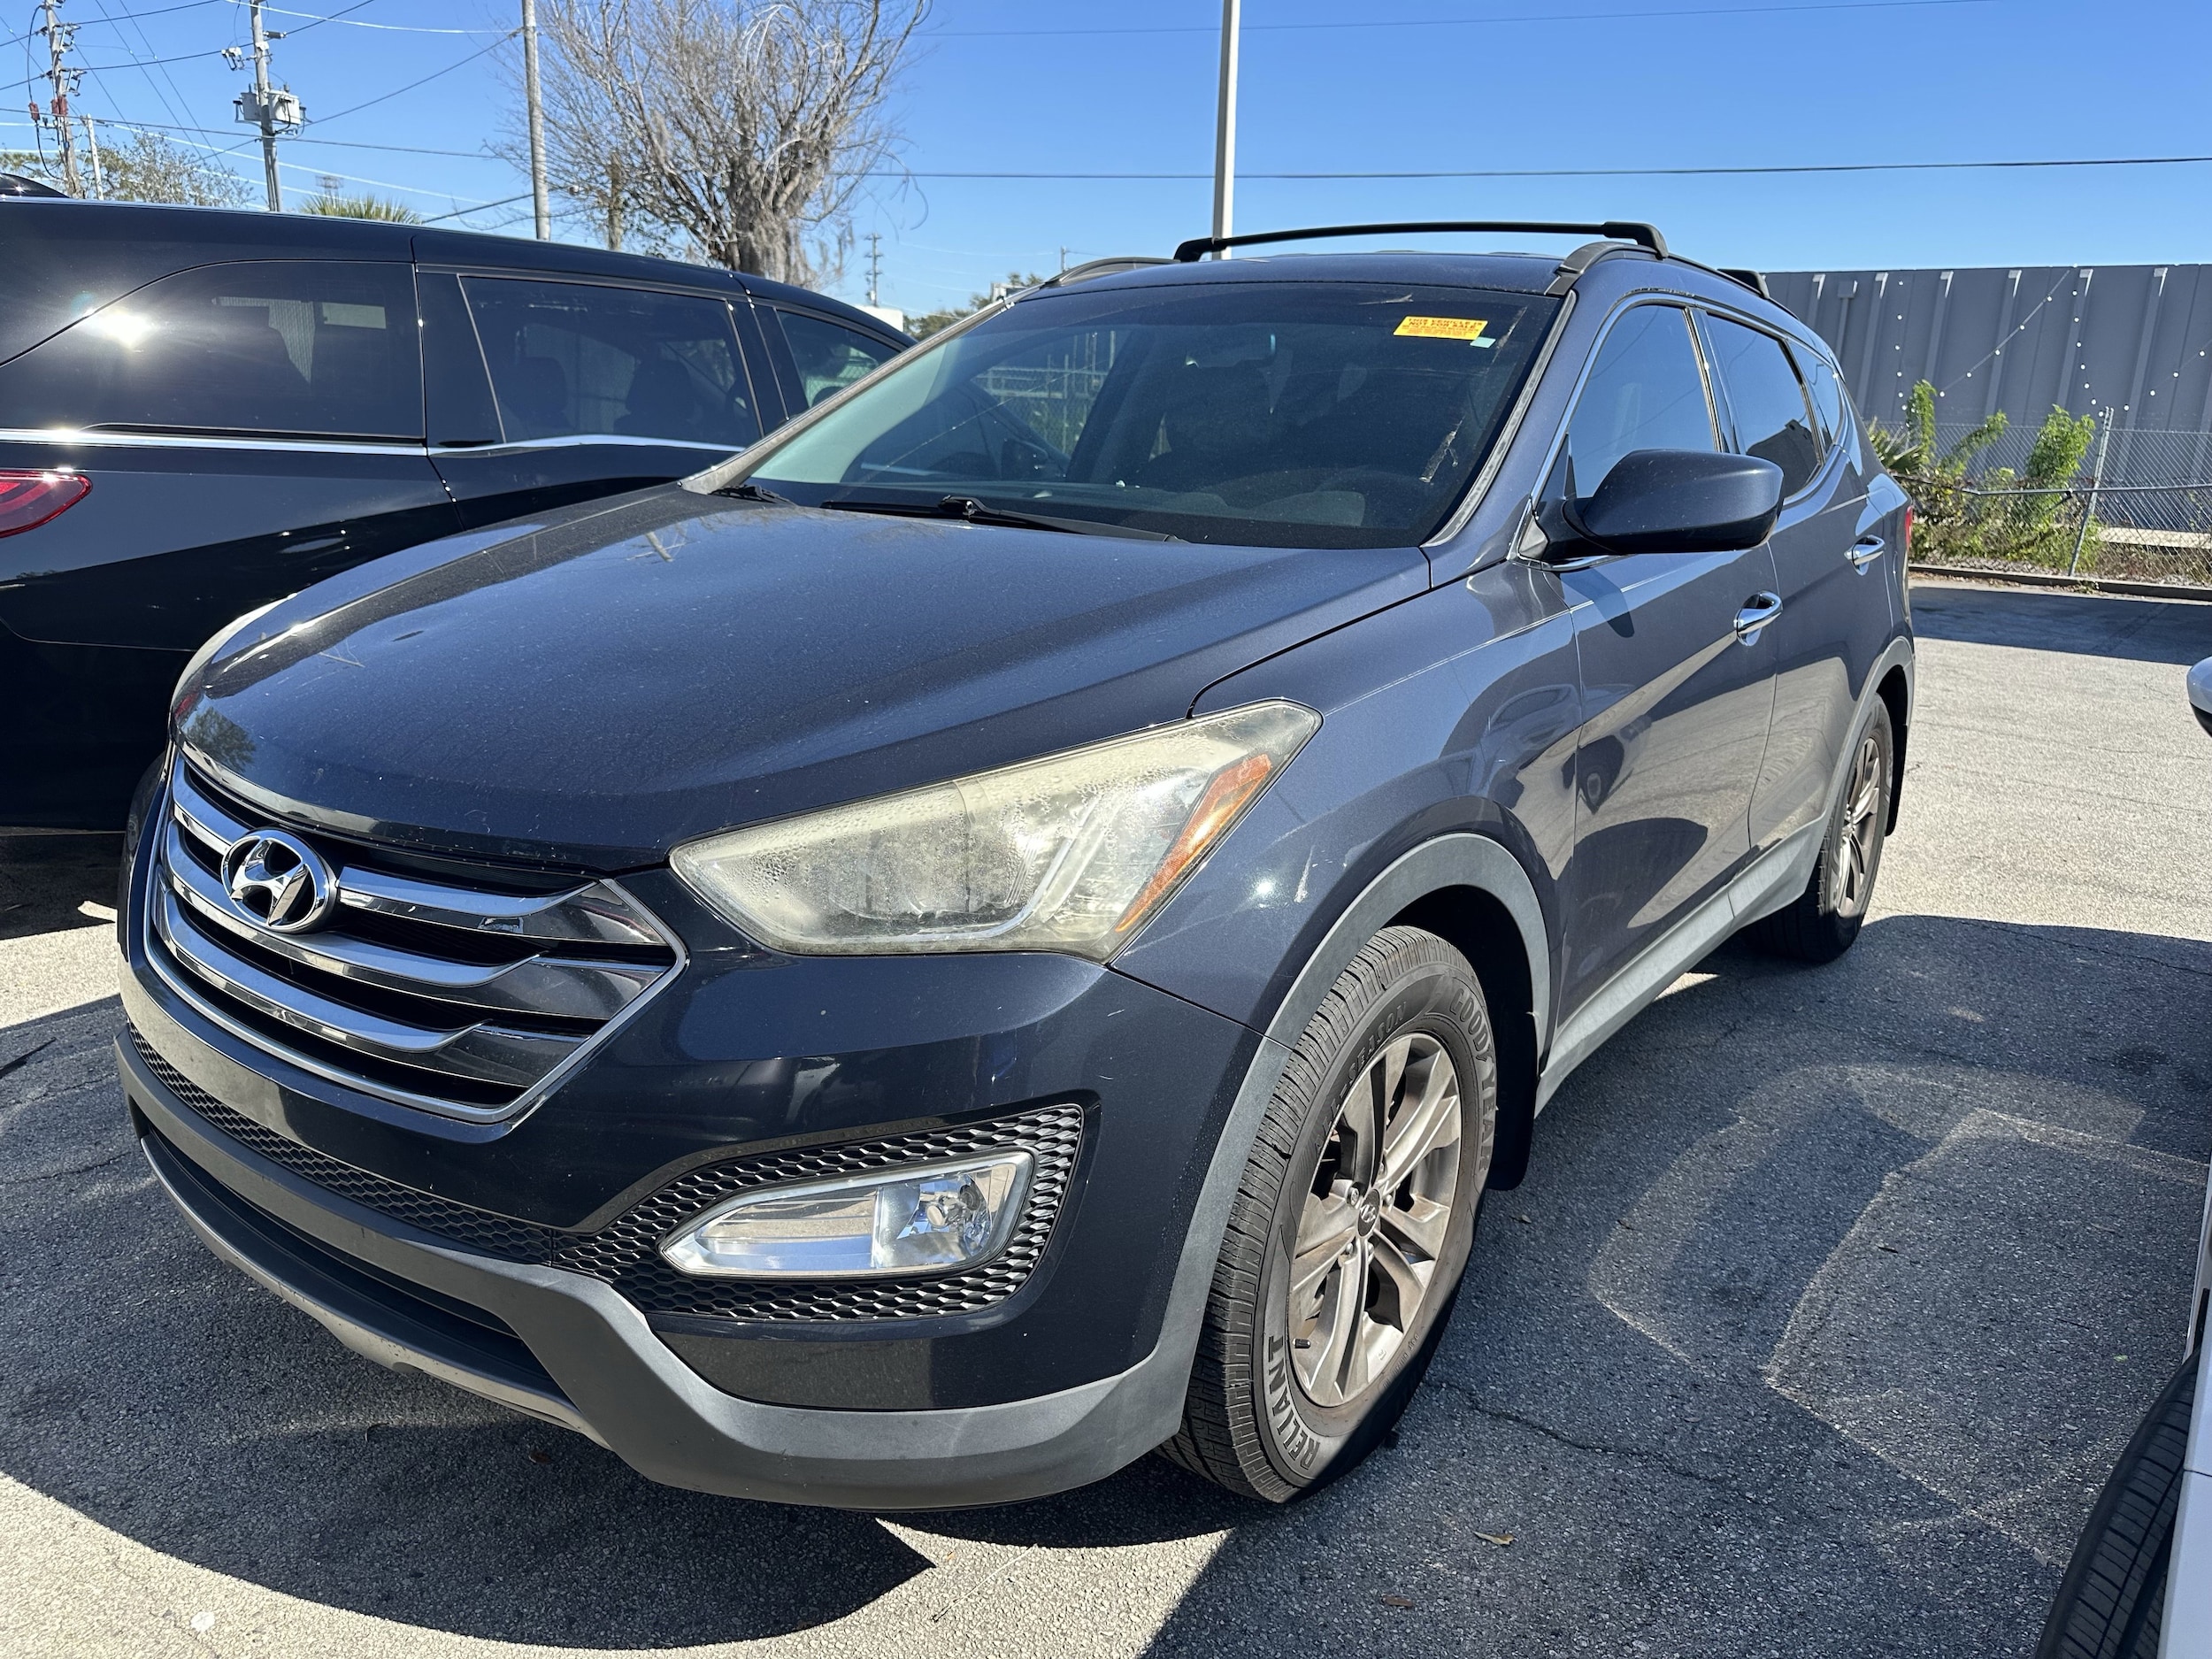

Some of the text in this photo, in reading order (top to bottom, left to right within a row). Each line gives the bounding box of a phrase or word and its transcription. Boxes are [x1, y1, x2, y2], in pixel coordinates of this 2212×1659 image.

[1314, 1001, 1407, 1159] ALL-SEASON
[1448, 987, 1495, 1172] GOODYEAR
[1268, 1335, 1321, 1471] RELIANT
